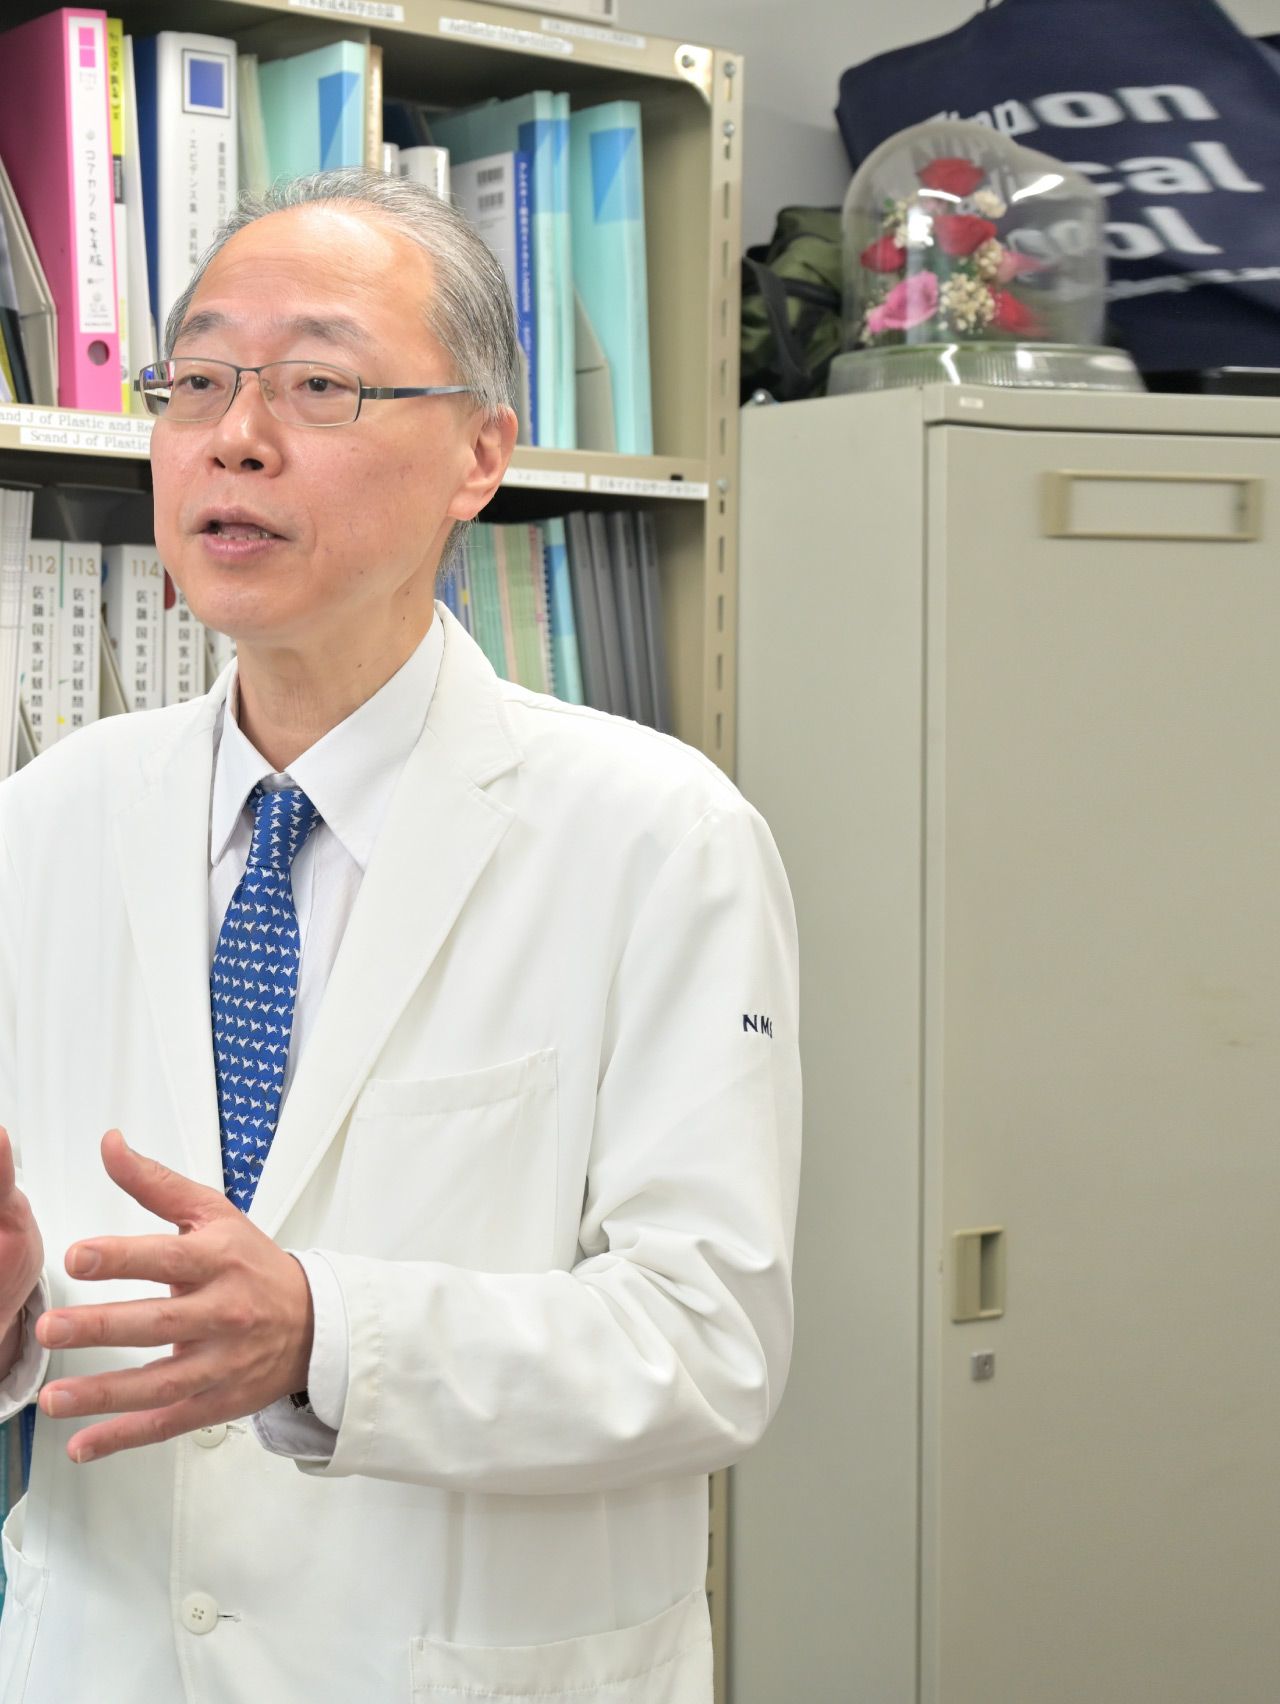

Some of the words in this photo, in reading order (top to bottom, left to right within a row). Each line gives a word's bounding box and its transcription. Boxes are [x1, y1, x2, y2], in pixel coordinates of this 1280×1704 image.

[27, 411, 35, 424] J
[38, 412, 53, 425] of
[58, 414, 105, 430] Plastic
[109, 417, 132, 433] and
[136, 418, 152, 434] Re
[30, 430, 69, 446] Scand
[73, 432, 81, 446] J
[85, 433, 100, 447] of
[106, 435, 151, 451] Plastic
[27, 555, 57, 575] 112
[69, 557, 97, 577] 113
[131, 559, 159, 578] 114
